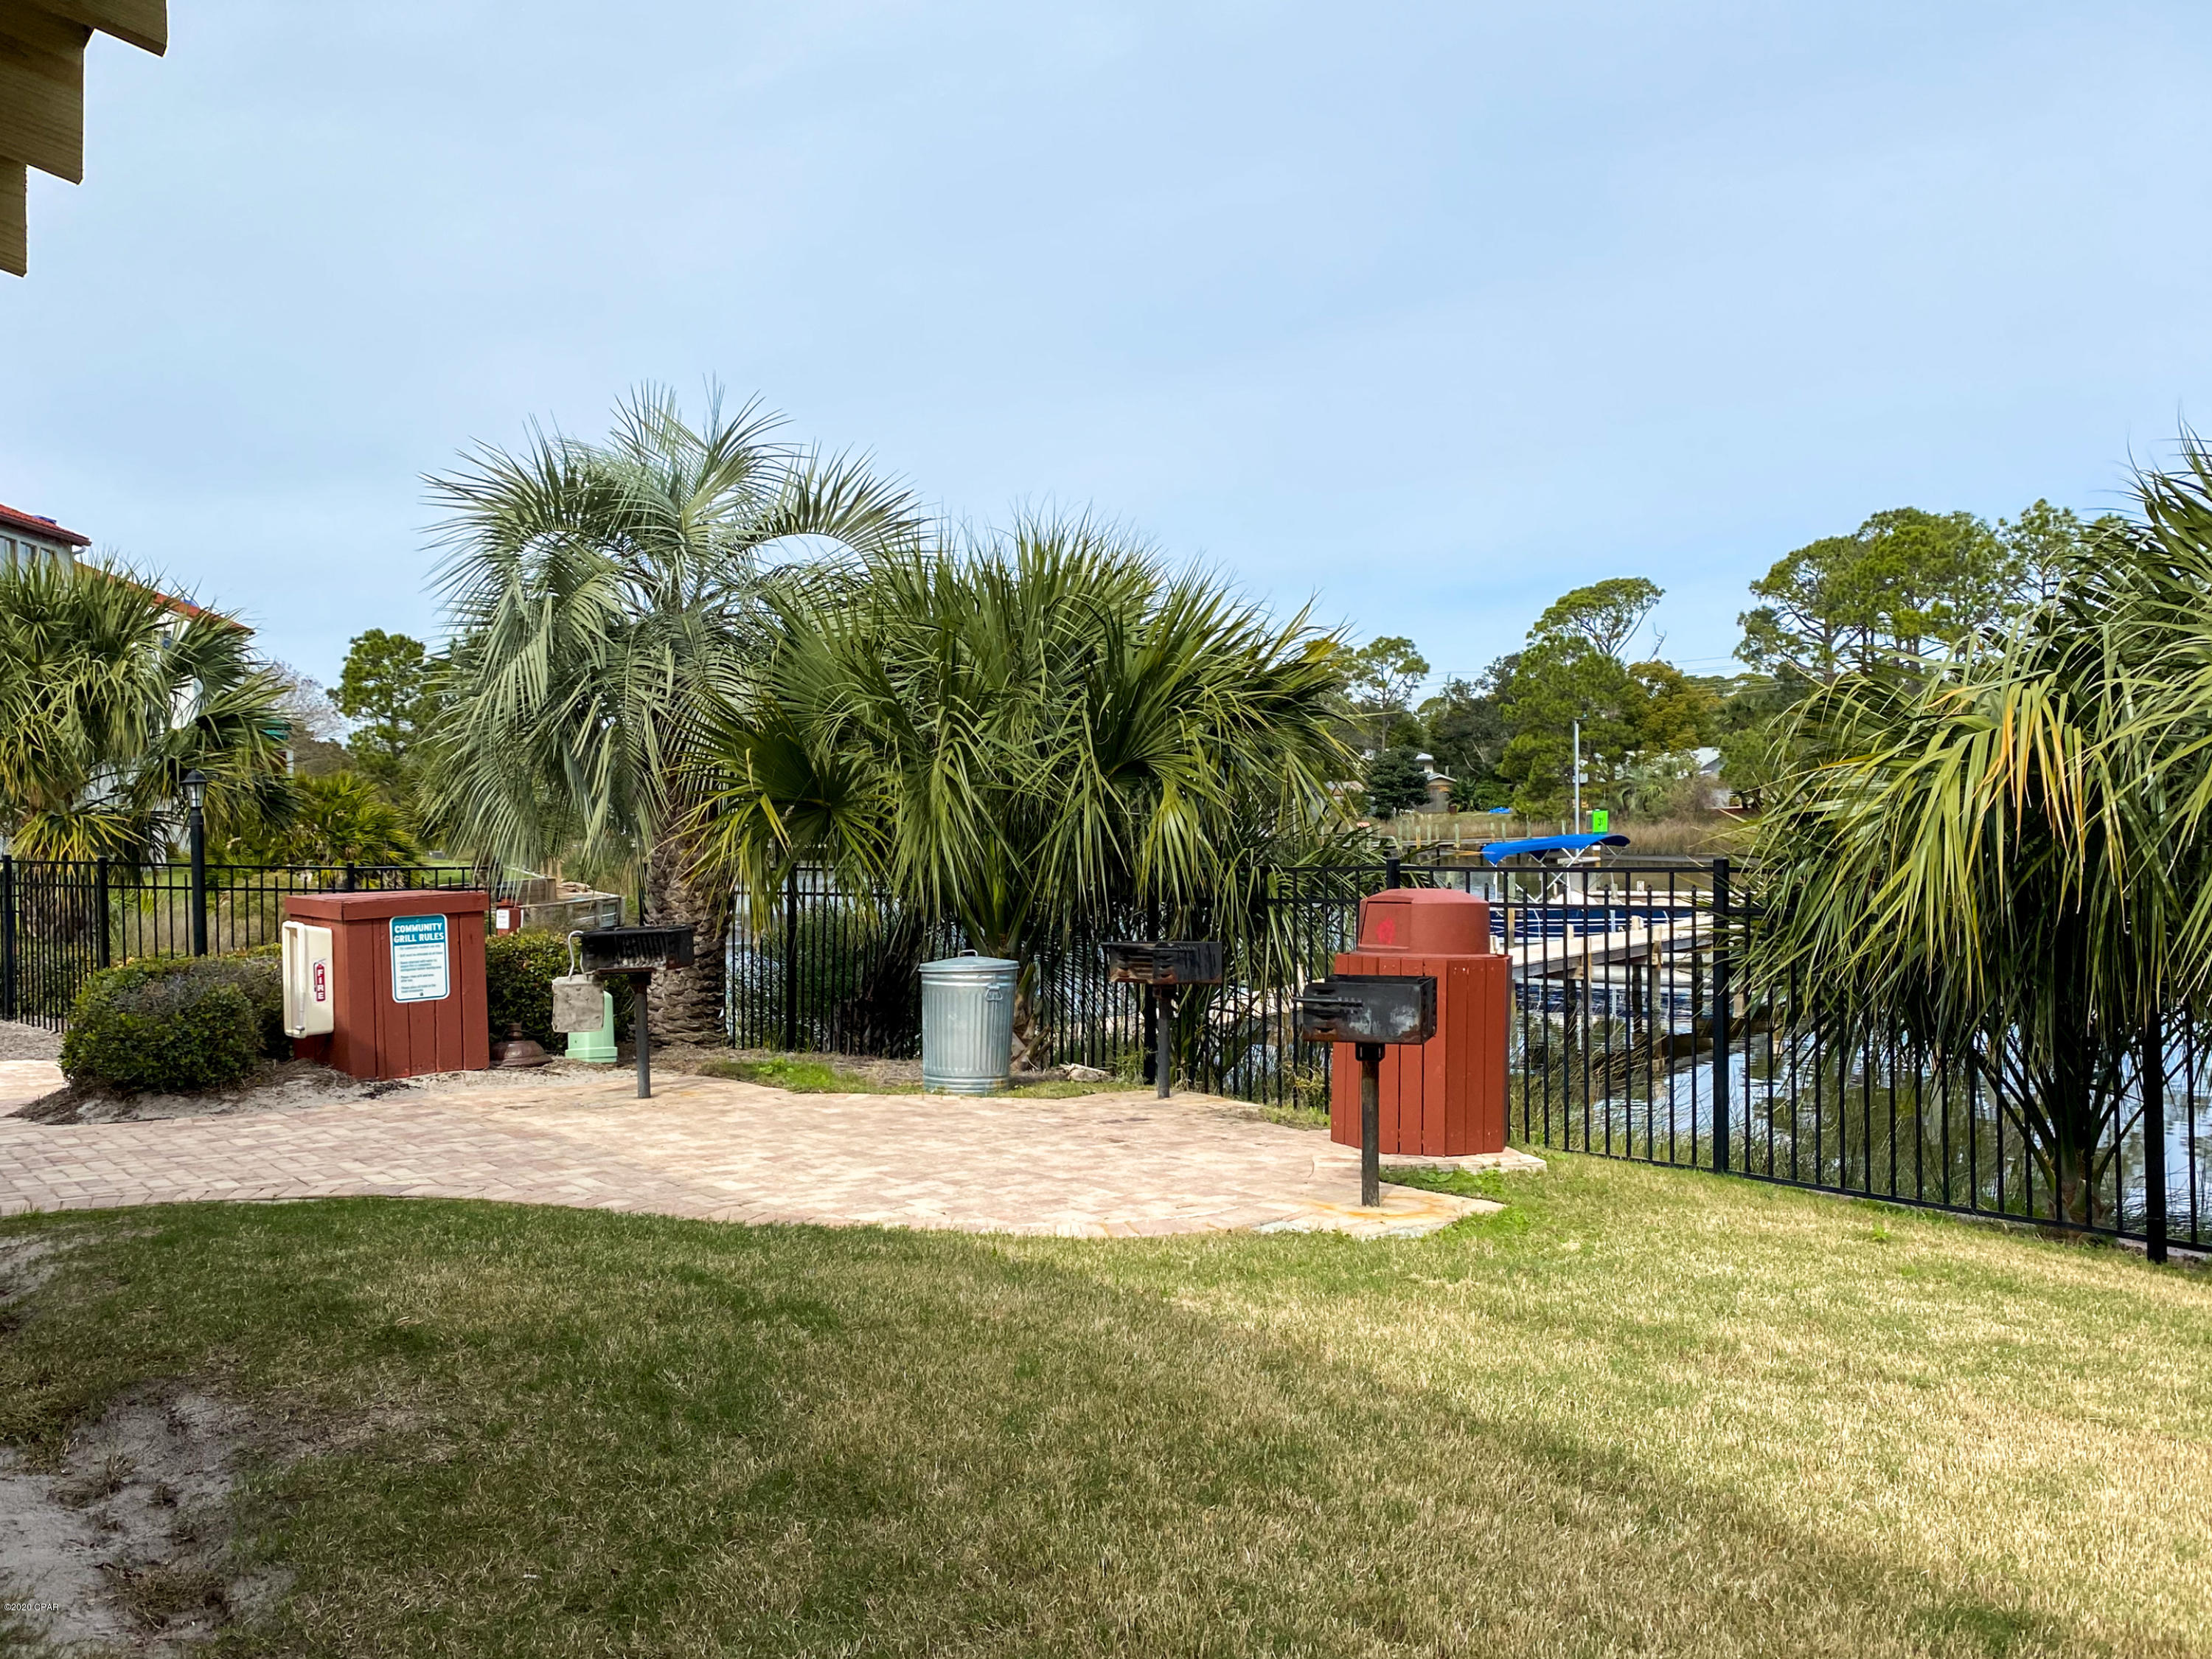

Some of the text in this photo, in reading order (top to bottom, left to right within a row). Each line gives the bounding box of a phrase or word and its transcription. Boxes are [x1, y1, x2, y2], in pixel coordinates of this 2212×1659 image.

[394, 923, 442, 933] COMMUNITY
[394, 932, 444, 943] GRILL RULES
